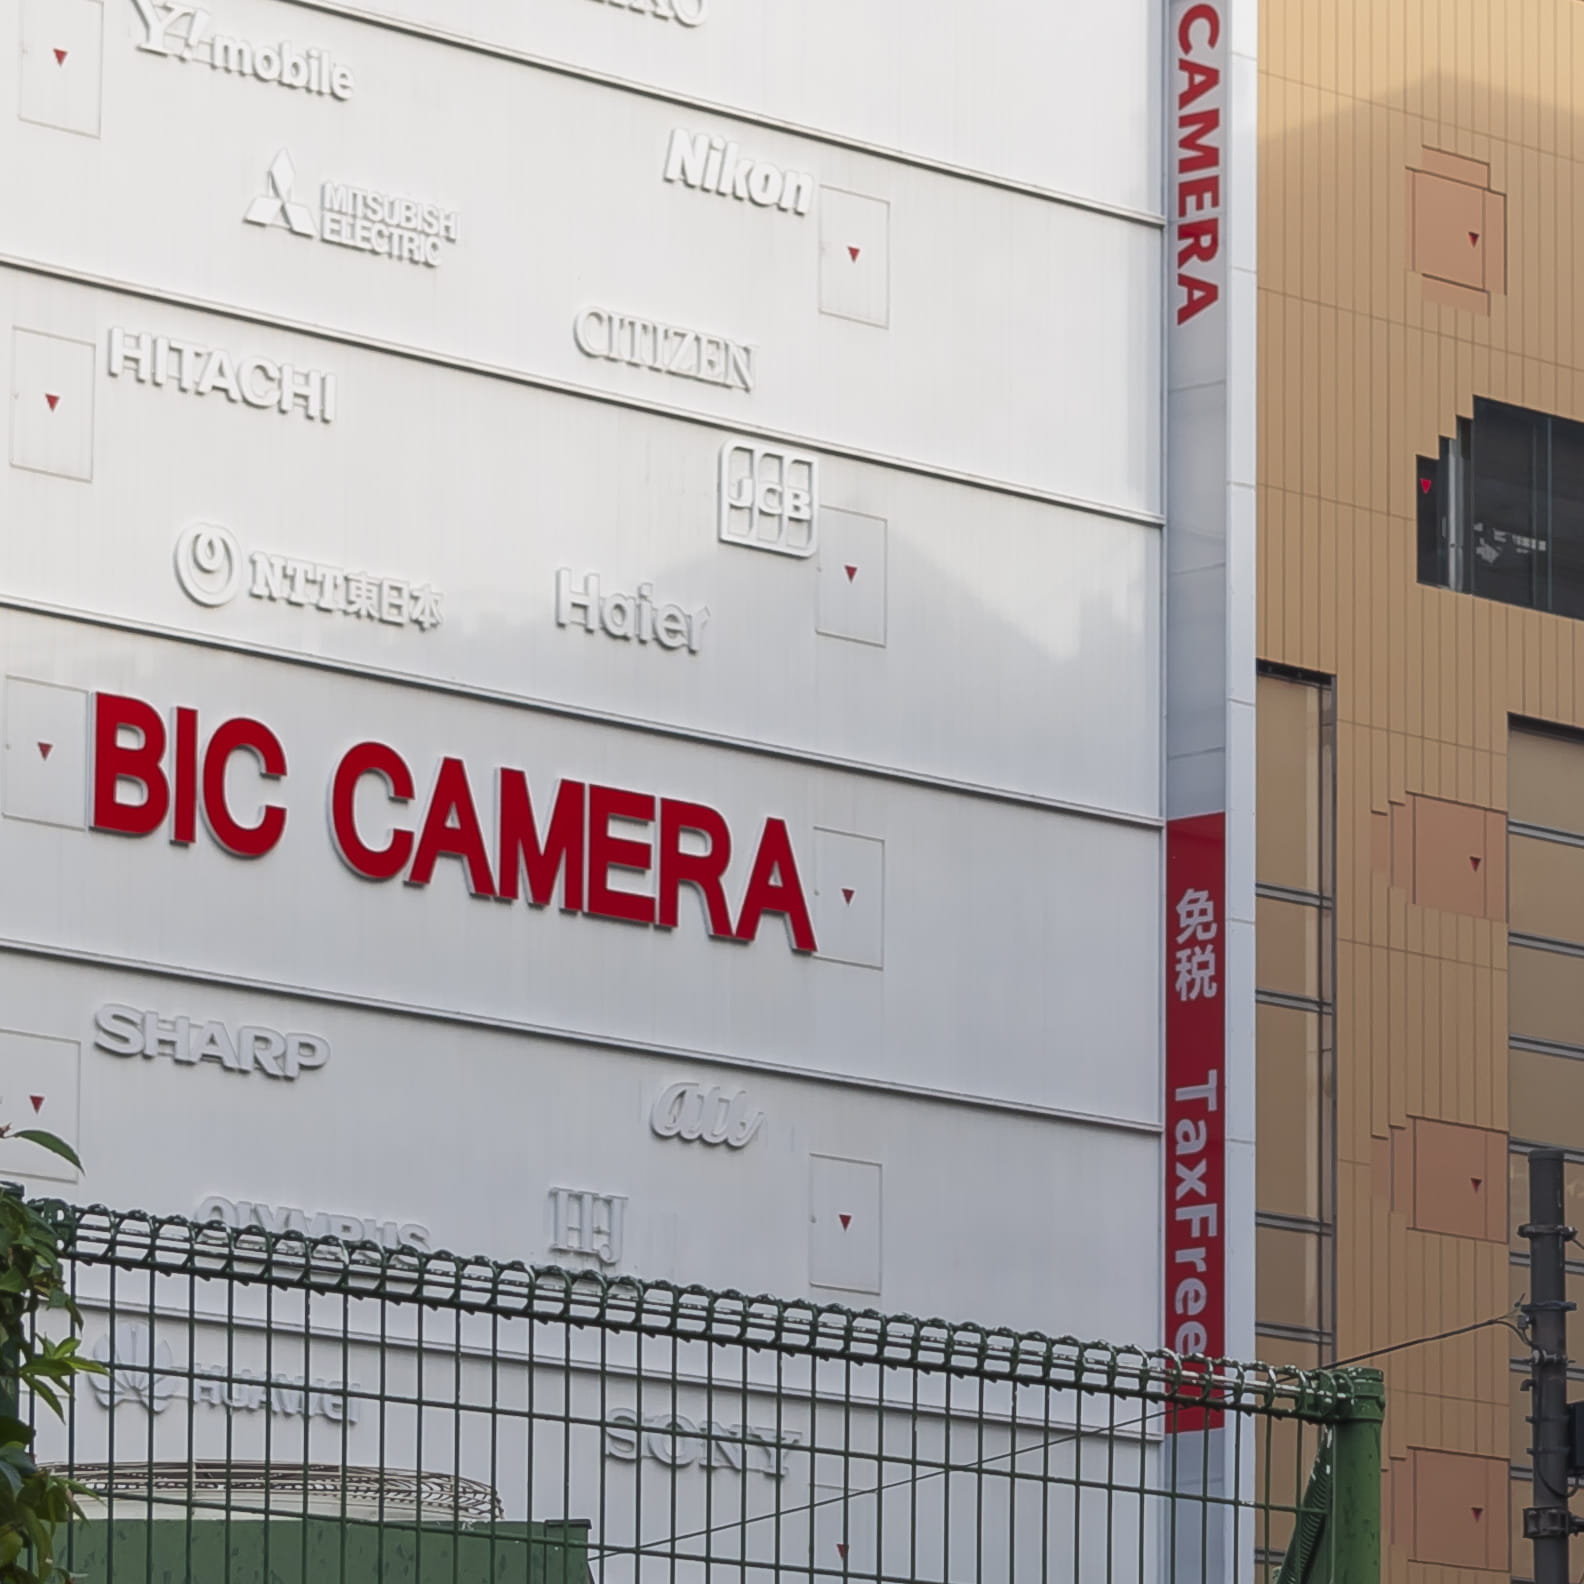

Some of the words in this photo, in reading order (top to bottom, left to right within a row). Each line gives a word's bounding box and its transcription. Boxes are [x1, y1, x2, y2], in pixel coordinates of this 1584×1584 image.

[664, 128, 816, 216] Nikon
[1176, 3, 1221, 327] CAMERA
[320, 180, 462, 245] MITSUBISHI
[320, 210, 443, 268] ELECTRIC
[106, 328, 338, 423] HITACHI
[574, 307, 758, 393] CITIZEN
[554, 567, 711, 655] Haier
[89, 691, 287, 859] BIC
[328, 740, 818, 953] CAMERA
[1174, 887, 1218, 1002] 免税
[93, 1002, 330, 1081] SHARP
[604, 1407, 803, 1478] SONY
